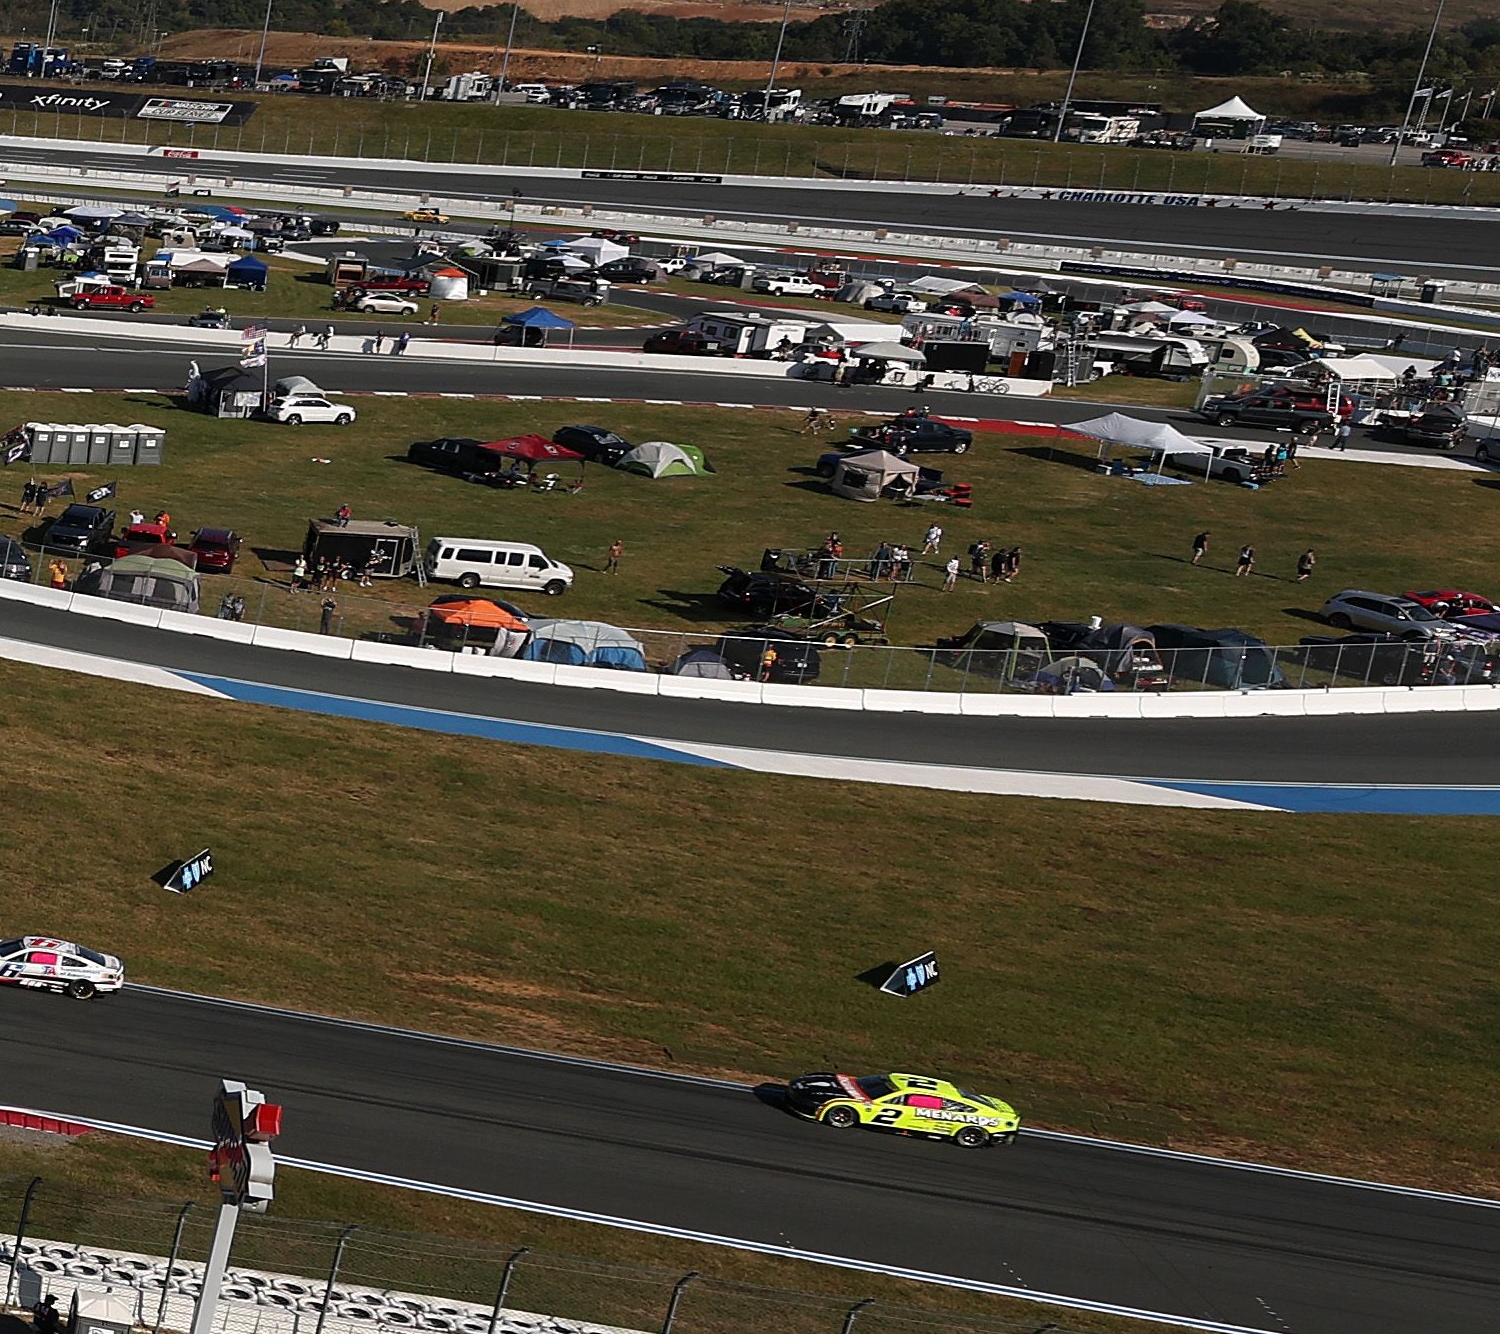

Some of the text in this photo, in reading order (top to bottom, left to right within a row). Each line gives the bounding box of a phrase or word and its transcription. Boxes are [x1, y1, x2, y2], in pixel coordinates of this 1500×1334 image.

[29, 94, 111, 111] xfinity
[1058, 190, 1199, 207] CHARLOTTE USA
[200, 854, 212, 875] NC
[925, 956, 939, 980] NC
[907, 1077, 939, 1091] 2
[875, 1108, 1001, 1127] 2 MENARDS
